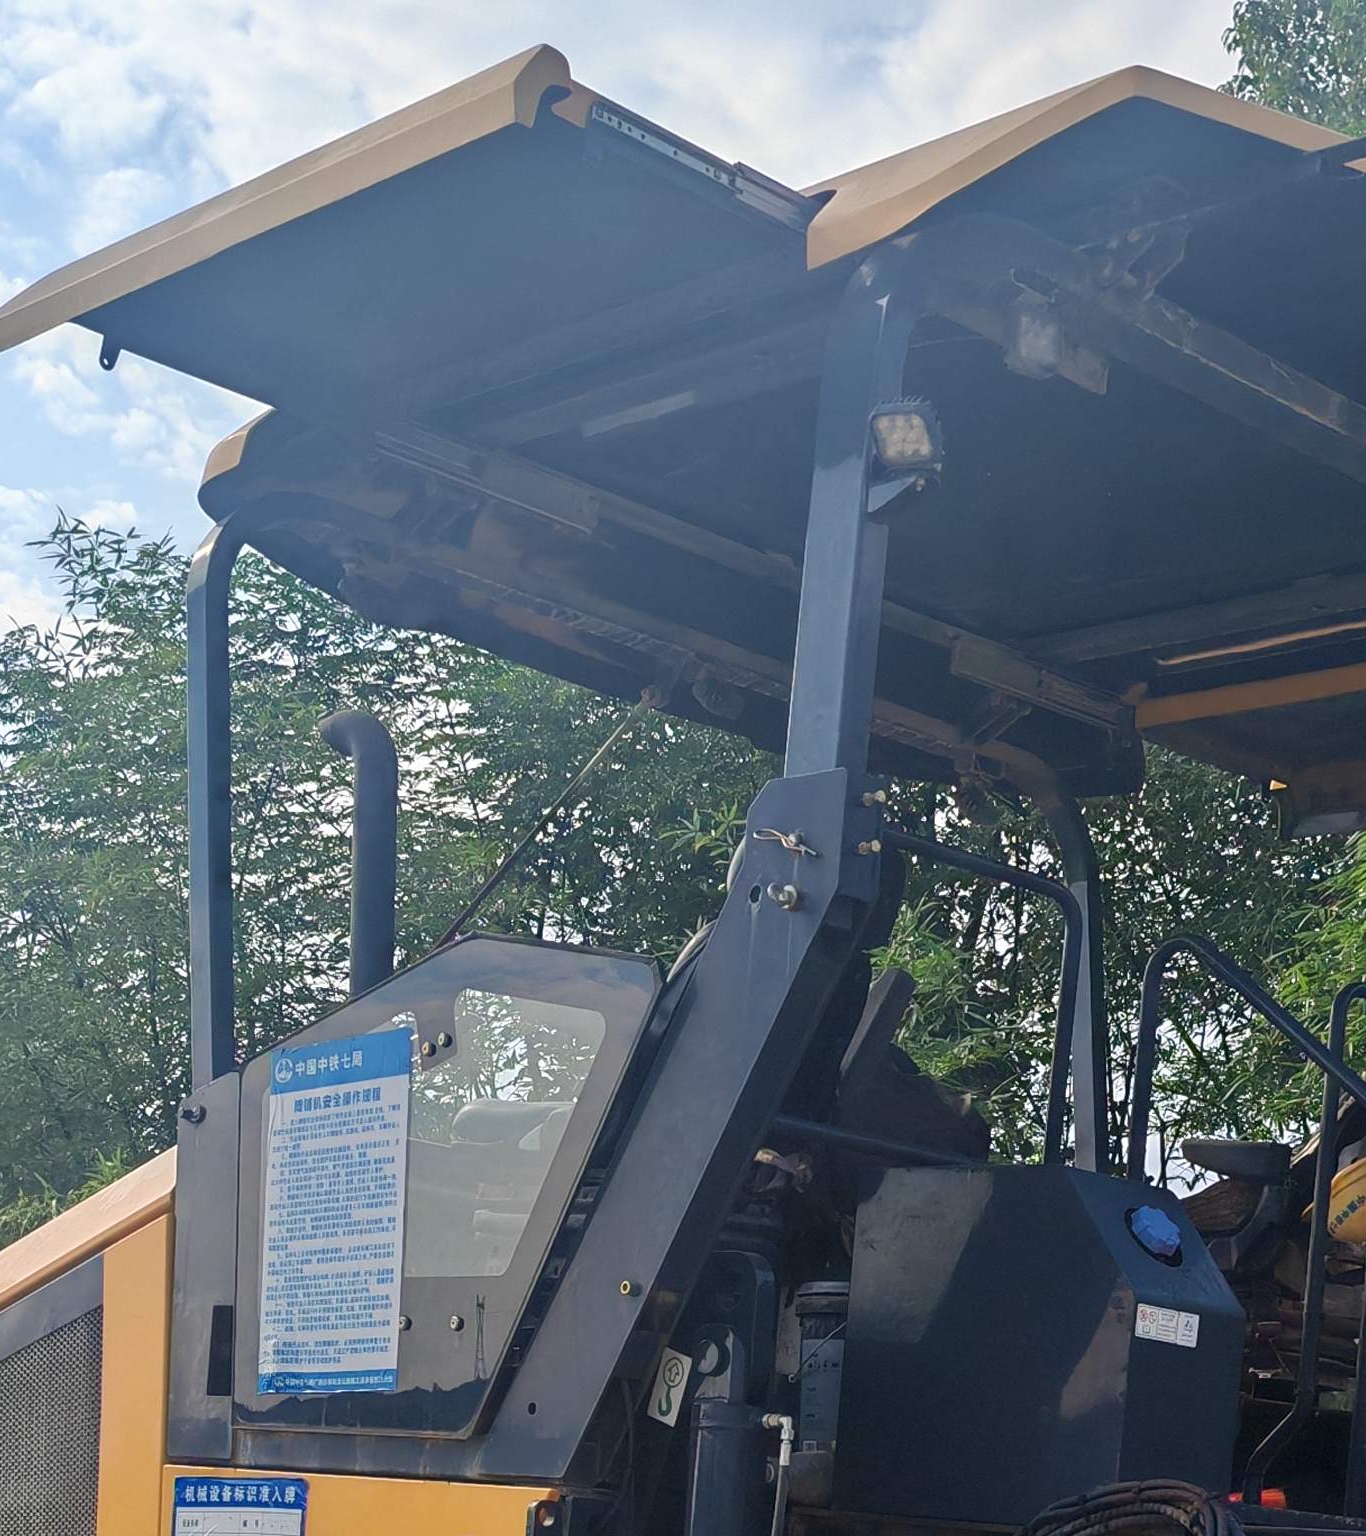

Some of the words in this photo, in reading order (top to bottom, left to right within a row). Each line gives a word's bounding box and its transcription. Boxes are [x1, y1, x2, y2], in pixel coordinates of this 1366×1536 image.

[295, 1050, 363, 1077] 中国中铁七局
[184, 1484, 296, 1505] 机械设备标识准入牌
